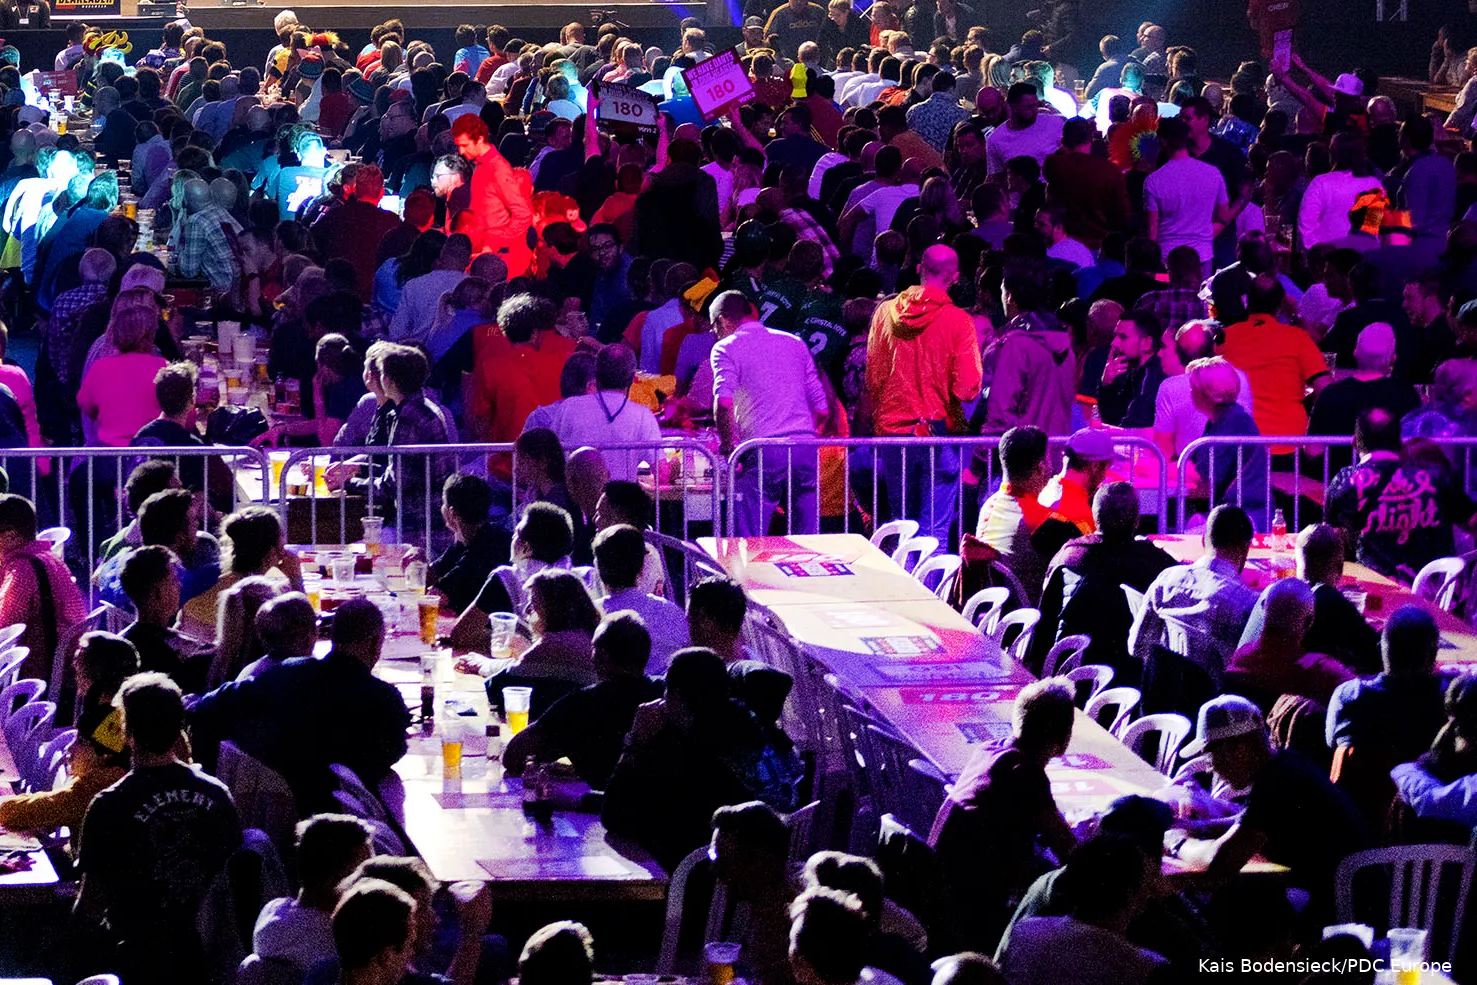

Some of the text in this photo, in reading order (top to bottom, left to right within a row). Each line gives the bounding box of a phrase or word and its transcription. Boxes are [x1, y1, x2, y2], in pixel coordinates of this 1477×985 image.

[685, 50, 734, 81] WE HAVE DARTS
[707, 79, 735, 102] 180
[613, 101, 643, 117] 180
